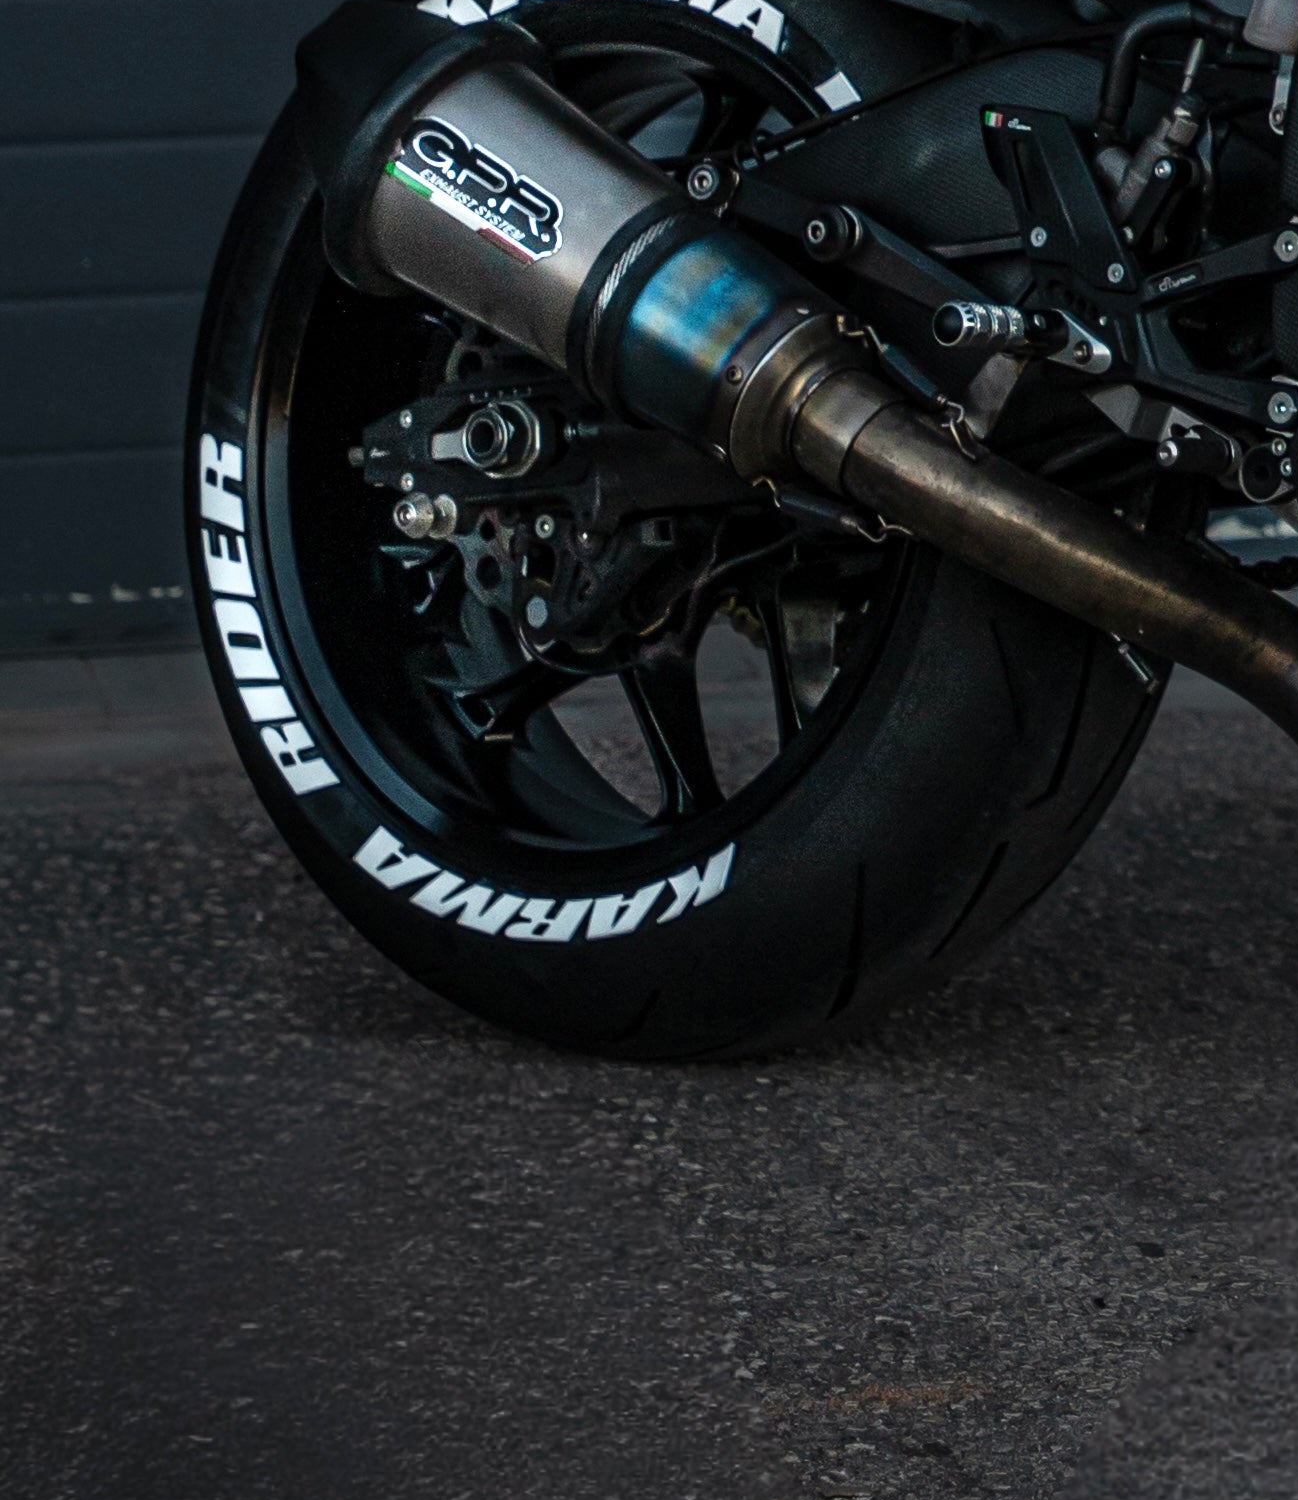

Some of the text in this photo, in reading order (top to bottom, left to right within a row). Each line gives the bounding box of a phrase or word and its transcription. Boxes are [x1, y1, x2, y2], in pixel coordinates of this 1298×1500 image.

[419, 168, 527, 241] EXHAUST SYSTEM
[200, 432, 340, 796] RIDER
[353, 824, 736, 943] KARMA
